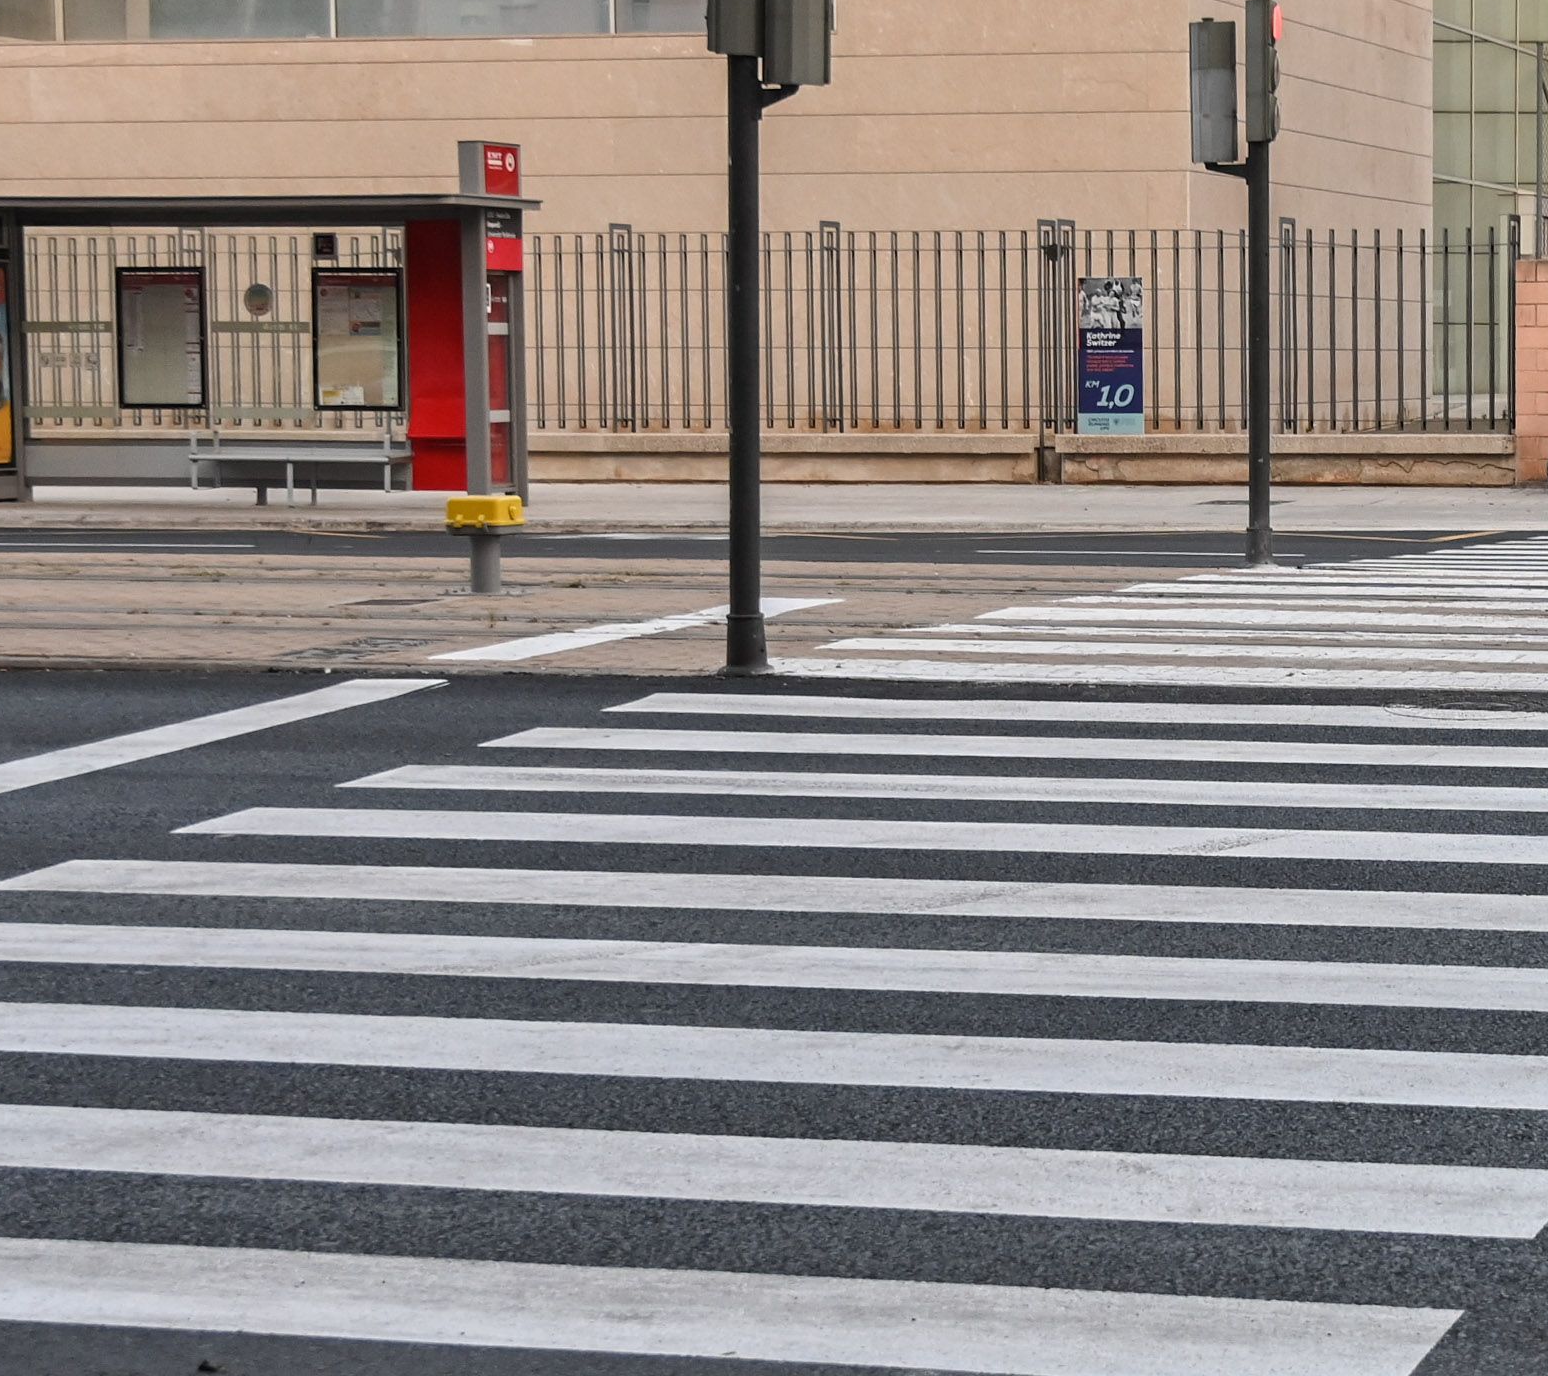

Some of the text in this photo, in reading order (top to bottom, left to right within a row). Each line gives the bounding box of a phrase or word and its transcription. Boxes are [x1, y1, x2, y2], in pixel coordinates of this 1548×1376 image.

[1086, 331, 1121, 340] Kathrine
[1086, 339, 1117, 347] Switzer
[1085, 380, 1100, 389] KM
[1096, 384, 1135, 410] 1,0
